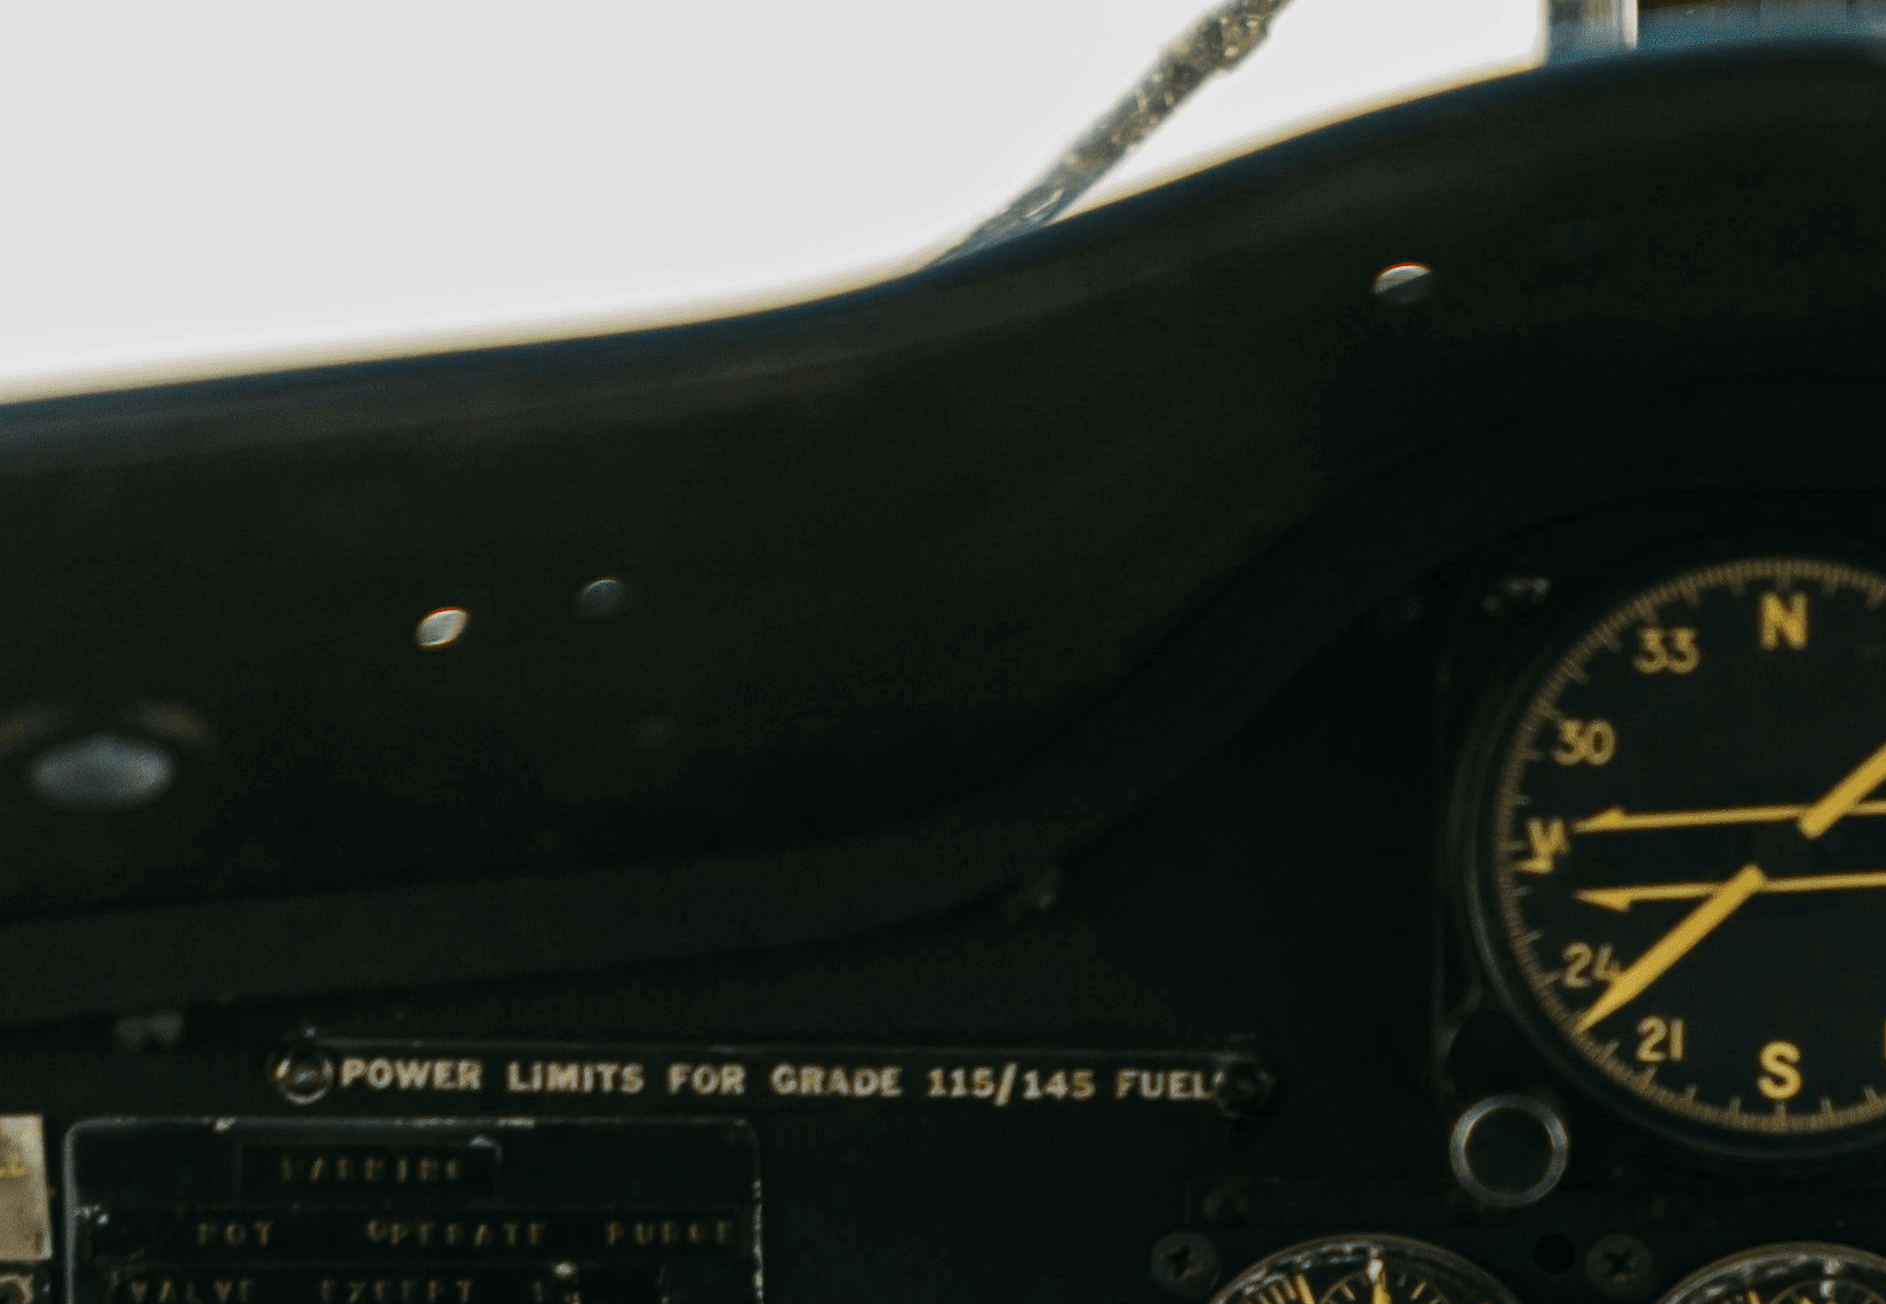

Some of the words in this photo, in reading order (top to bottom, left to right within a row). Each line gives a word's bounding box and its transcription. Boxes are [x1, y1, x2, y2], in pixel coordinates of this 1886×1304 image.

[1759, 592, 1809, 650] N
[1634, 627, 1699, 674] 33
[1554, 719, 1615, 766] 30
[1636, 1016, 1684, 1062] 21
[339, 1056, 483, 1092] POWER
[507, 1060, 646, 1095] LIMITS
[666, 1062, 747, 1096] FOR
[770, 1061, 903, 1099] GRADE
[927, 1061, 1096, 1107] 115/145
[1115, 1067, 1215, 1101] FUEL
[1758, 1041, 1801, 1100] S
